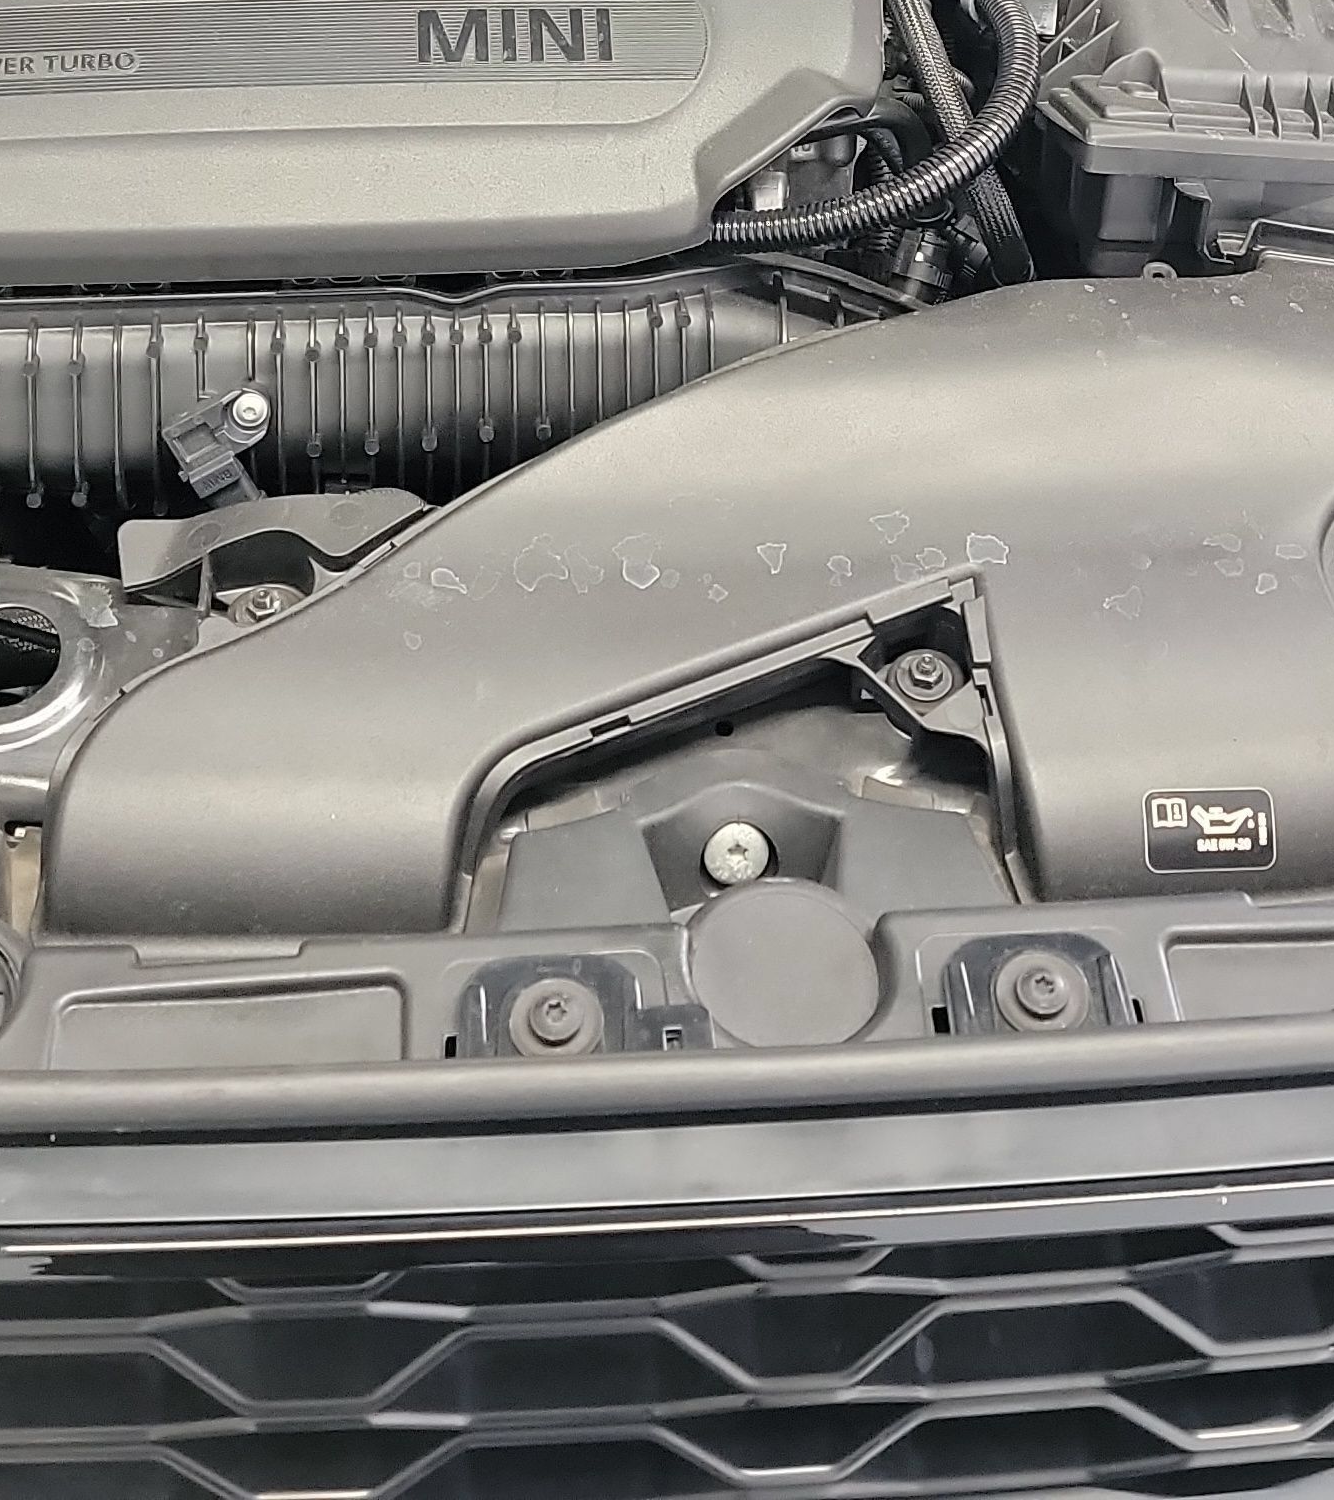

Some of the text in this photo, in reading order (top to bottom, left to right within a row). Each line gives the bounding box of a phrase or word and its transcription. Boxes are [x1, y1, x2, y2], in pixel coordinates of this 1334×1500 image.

[417, 7, 614, 64] MINI
[43, 50, 136, 75] TURBO
[1196, 838, 1219, 852] SAE
